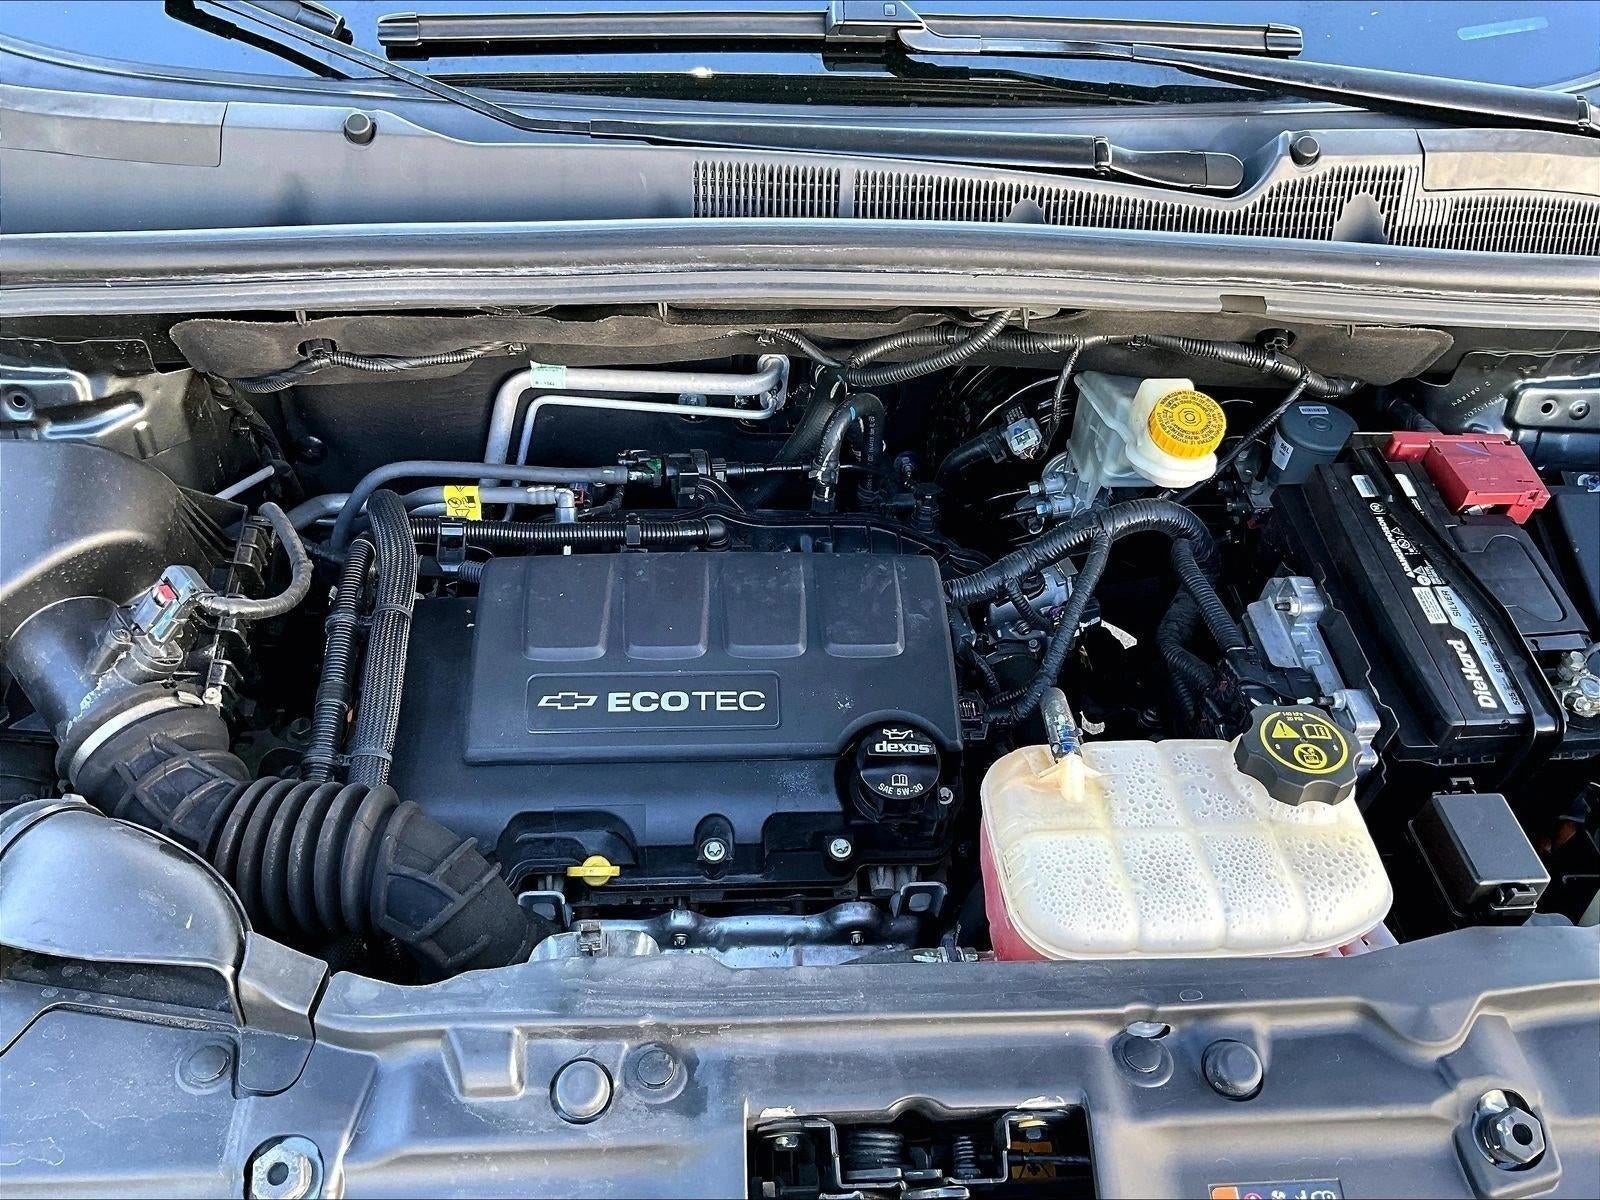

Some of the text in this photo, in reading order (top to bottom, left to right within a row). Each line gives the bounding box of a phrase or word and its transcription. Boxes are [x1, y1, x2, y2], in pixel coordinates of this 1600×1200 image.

[1440, 589, 1462, 617] SILVER
[1446, 639, 1498, 709] DieHard
[607, 691, 766, 712] ECOTEC
[875, 740, 931, 753] dexos
[878, 782, 924, 796] SAE 5W-30
